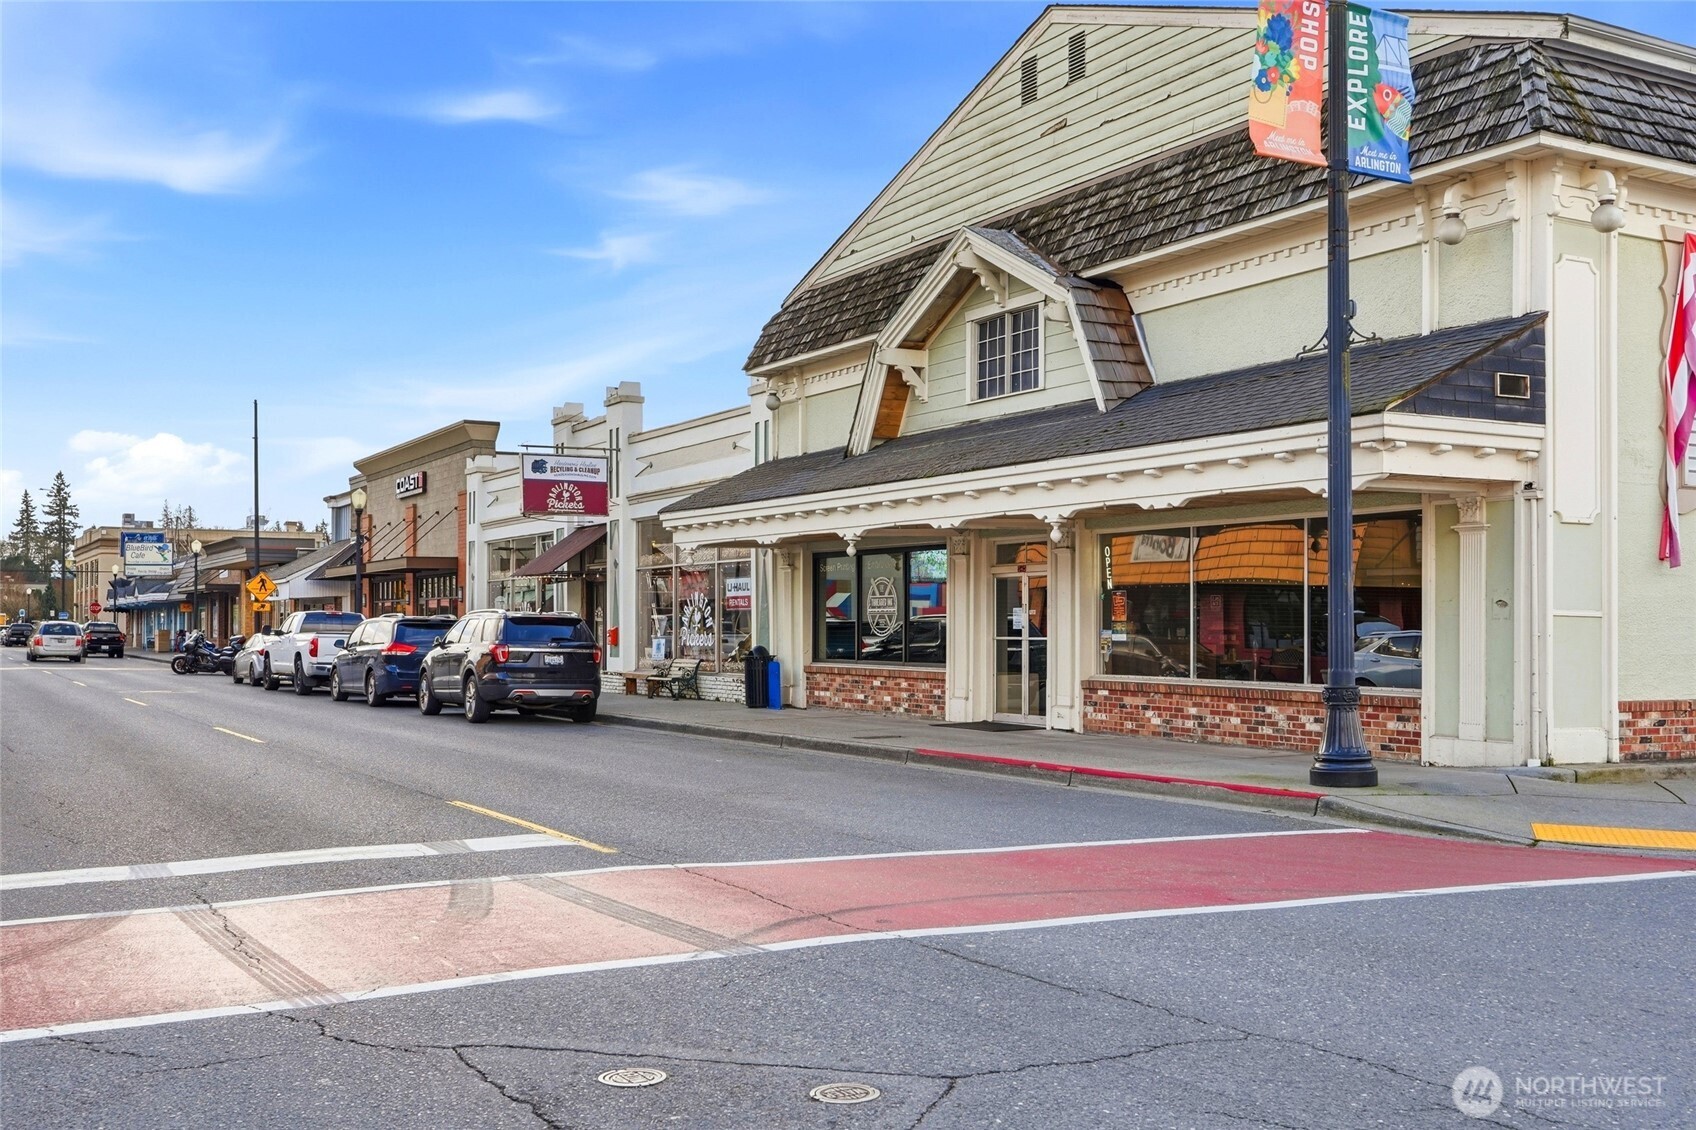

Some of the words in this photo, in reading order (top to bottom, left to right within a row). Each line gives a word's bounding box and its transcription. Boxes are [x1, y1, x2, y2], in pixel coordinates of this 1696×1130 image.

[1299, 1, 1321, 70] SHOP
[1347, 11, 1369, 131] EXPLORE
[1360, 145, 1378, 157] Meet
[1378, 150, 1389, 159] me
[1389, 152, 1397, 161] in
[1355, 156, 1401, 174] ARLINGTON
[579, 467, 601, 475] CLEANUP
[396, 471, 419, 494] COAST
[548, 482, 583, 501] ARLINGTON
[547, 498, 585, 509] Pickers
[126, 544, 154, 552] BlueBird
[130, 551, 146, 559] Cafe
[1104, 546, 1113, 590] OPEN
[727, 582, 750, 592] U-HAUL
[682, 591, 714, 628] ARLINGTON
[728, 598, 749, 606] RENTALS
[680, 626, 715, 647] Pickers
